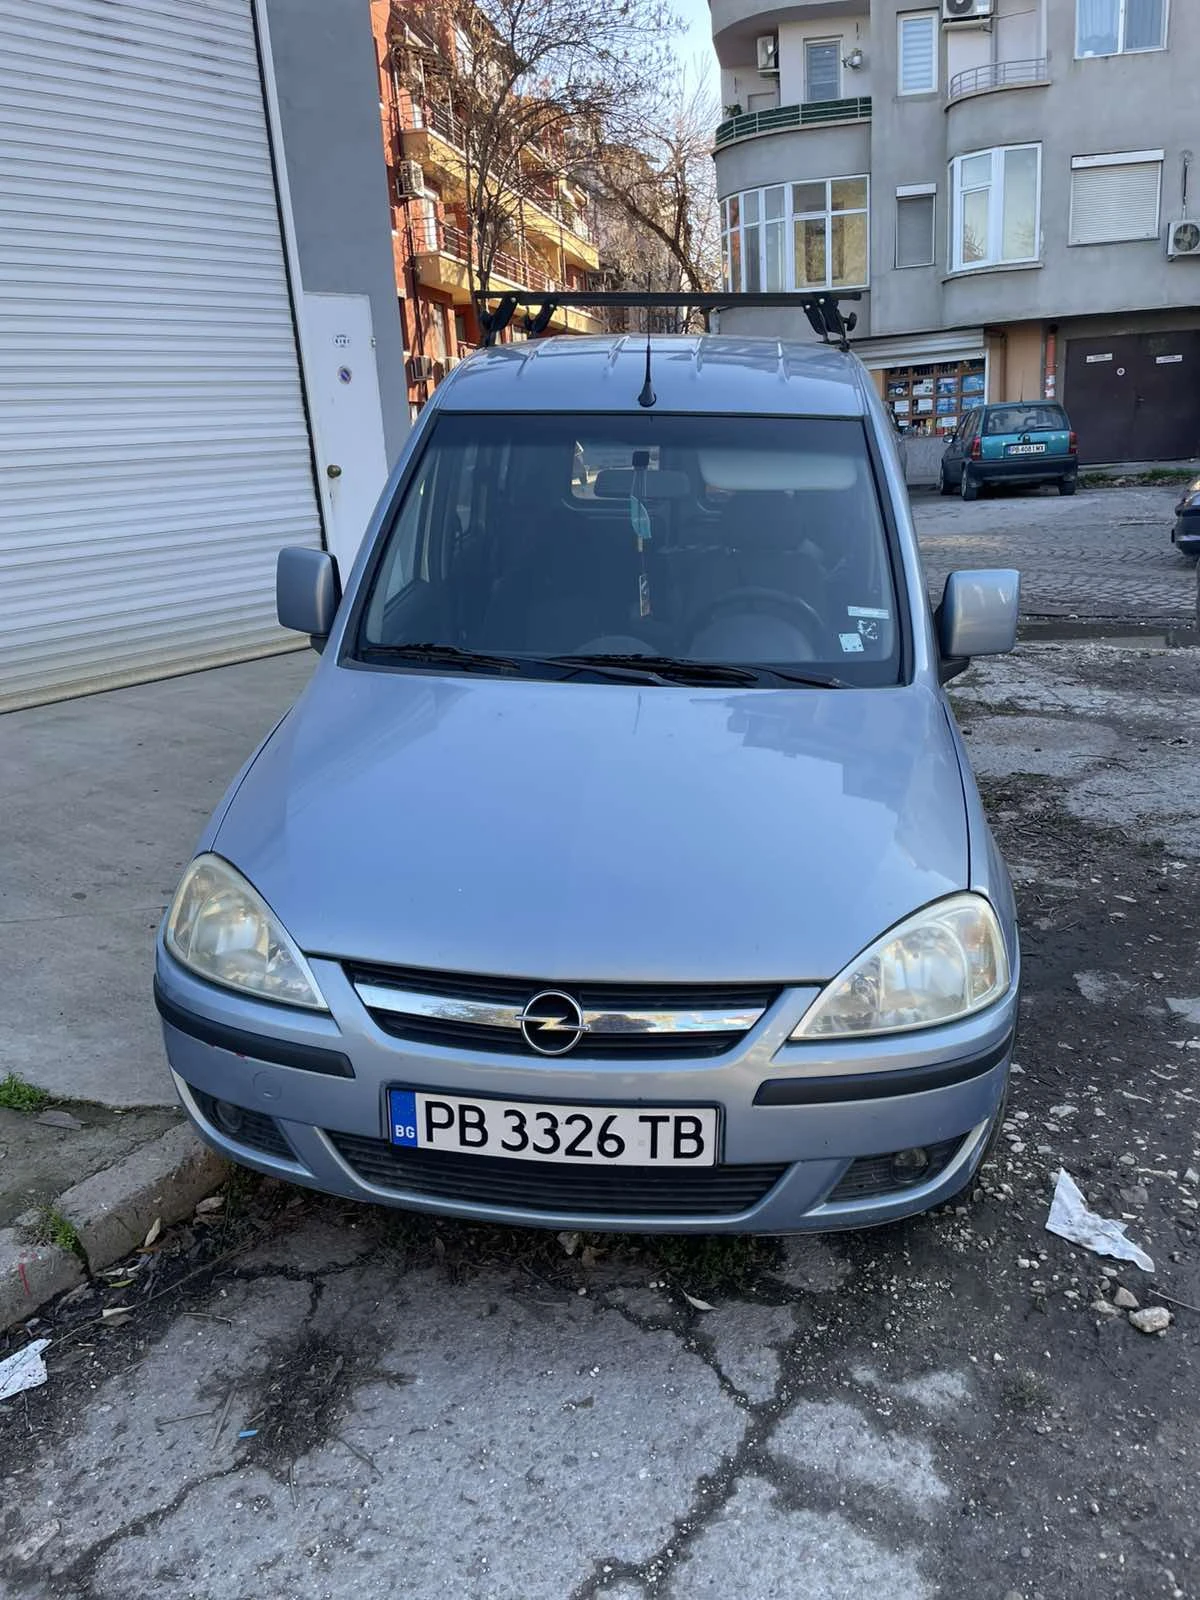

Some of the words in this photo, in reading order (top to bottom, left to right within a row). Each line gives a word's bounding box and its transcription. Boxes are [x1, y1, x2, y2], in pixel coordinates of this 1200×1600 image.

[395, 1124, 415, 1139] BG
[425, 1101, 489, 1148] PB
[501, 1110, 626, 1159] 3326
[638, 1115, 705, 1159] TB
